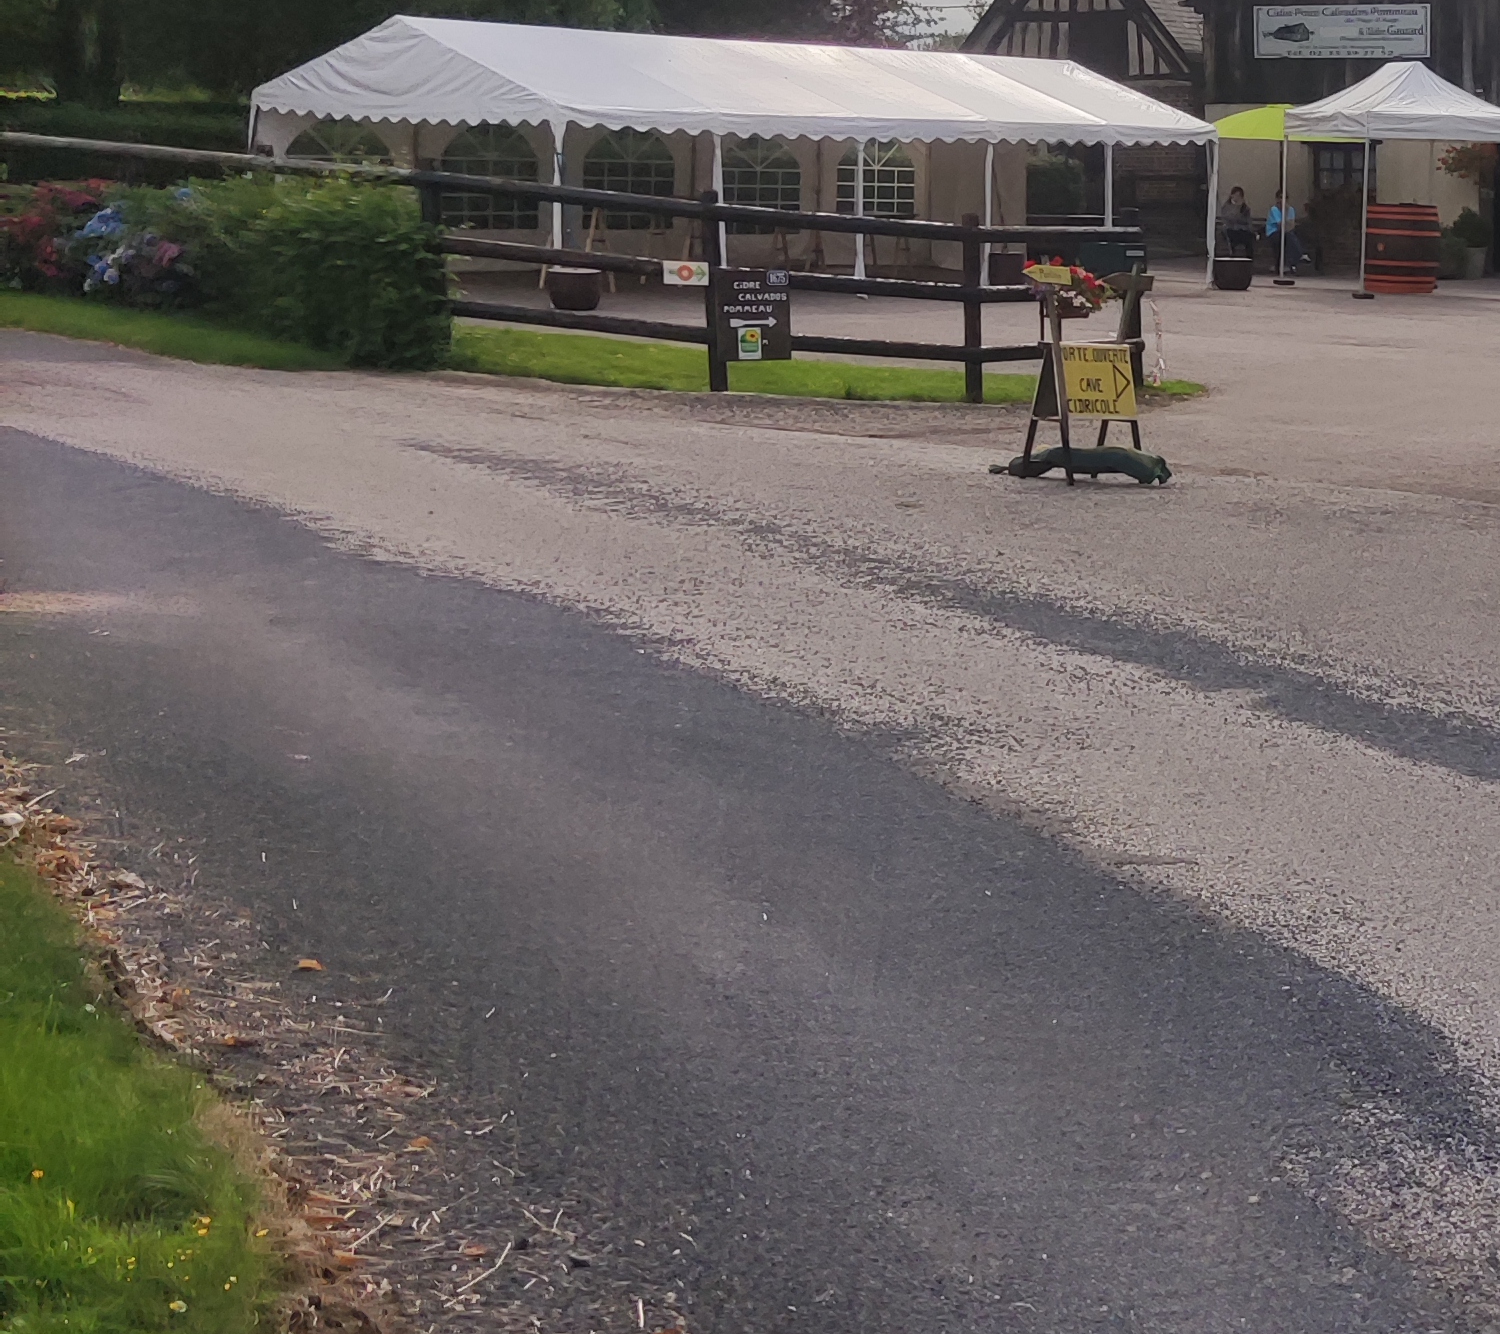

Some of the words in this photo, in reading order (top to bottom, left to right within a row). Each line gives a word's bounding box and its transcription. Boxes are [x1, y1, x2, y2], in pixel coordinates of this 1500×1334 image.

[769, 273, 786, 284] 1675
[738, 293, 787, 301] CALVADOS
[723, 305, 773, 313] POMMEAU
[1062, 347, 1089, 362] ORTE
[1079, 378, 1104, 393] CAVE
[1066, 398, 1121, 415] CIDRICOLE
